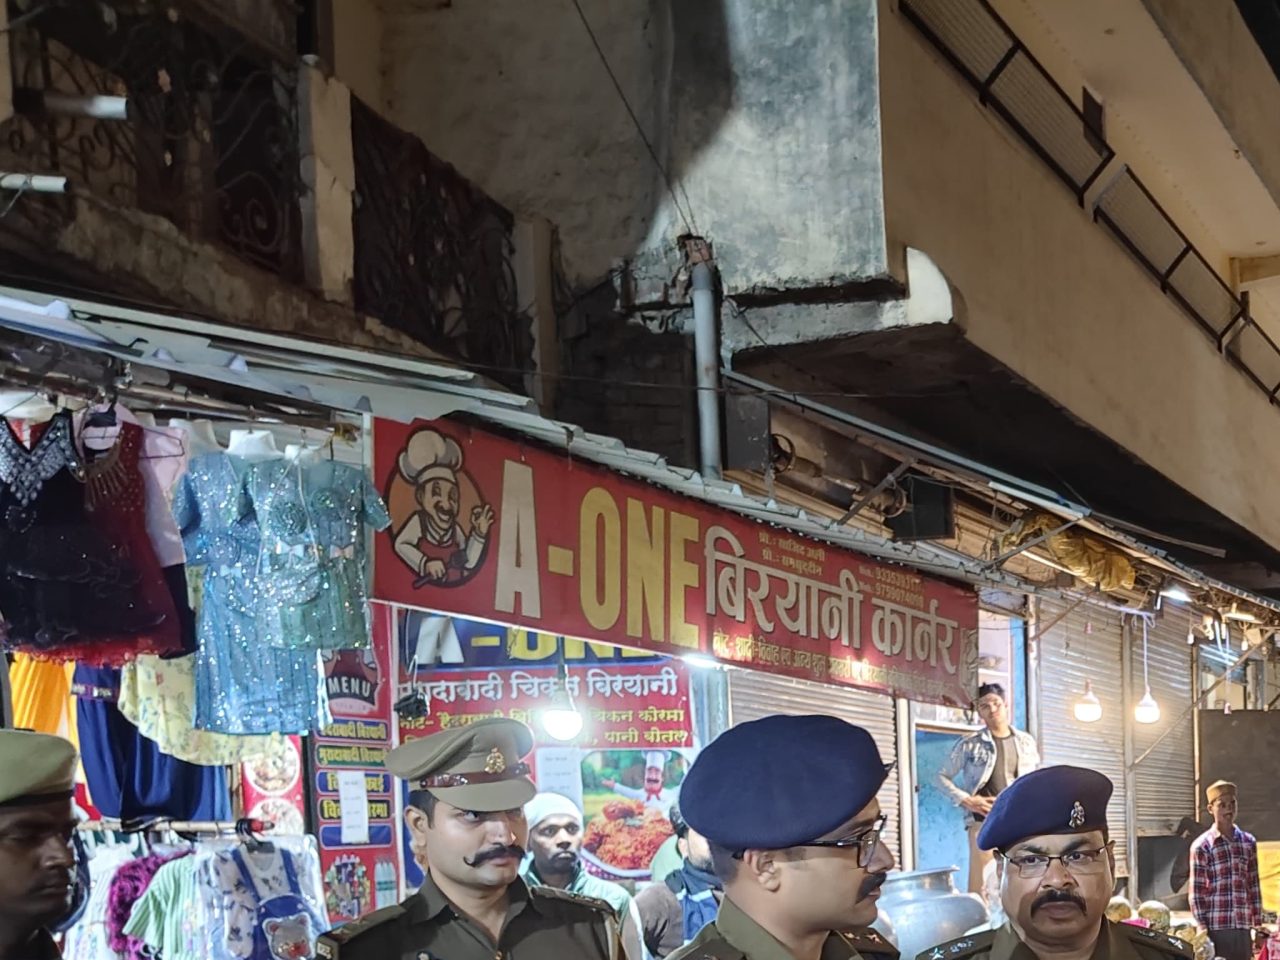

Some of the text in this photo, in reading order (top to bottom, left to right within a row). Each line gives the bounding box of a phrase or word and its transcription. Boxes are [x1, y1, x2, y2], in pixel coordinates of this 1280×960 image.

[494, 459, 699, 649] A-ONE
[704, 526, 863, 649] बिरयानी
[871, 598, 959, 675] कार्नर
[328, 676, 371, 698] MENU
